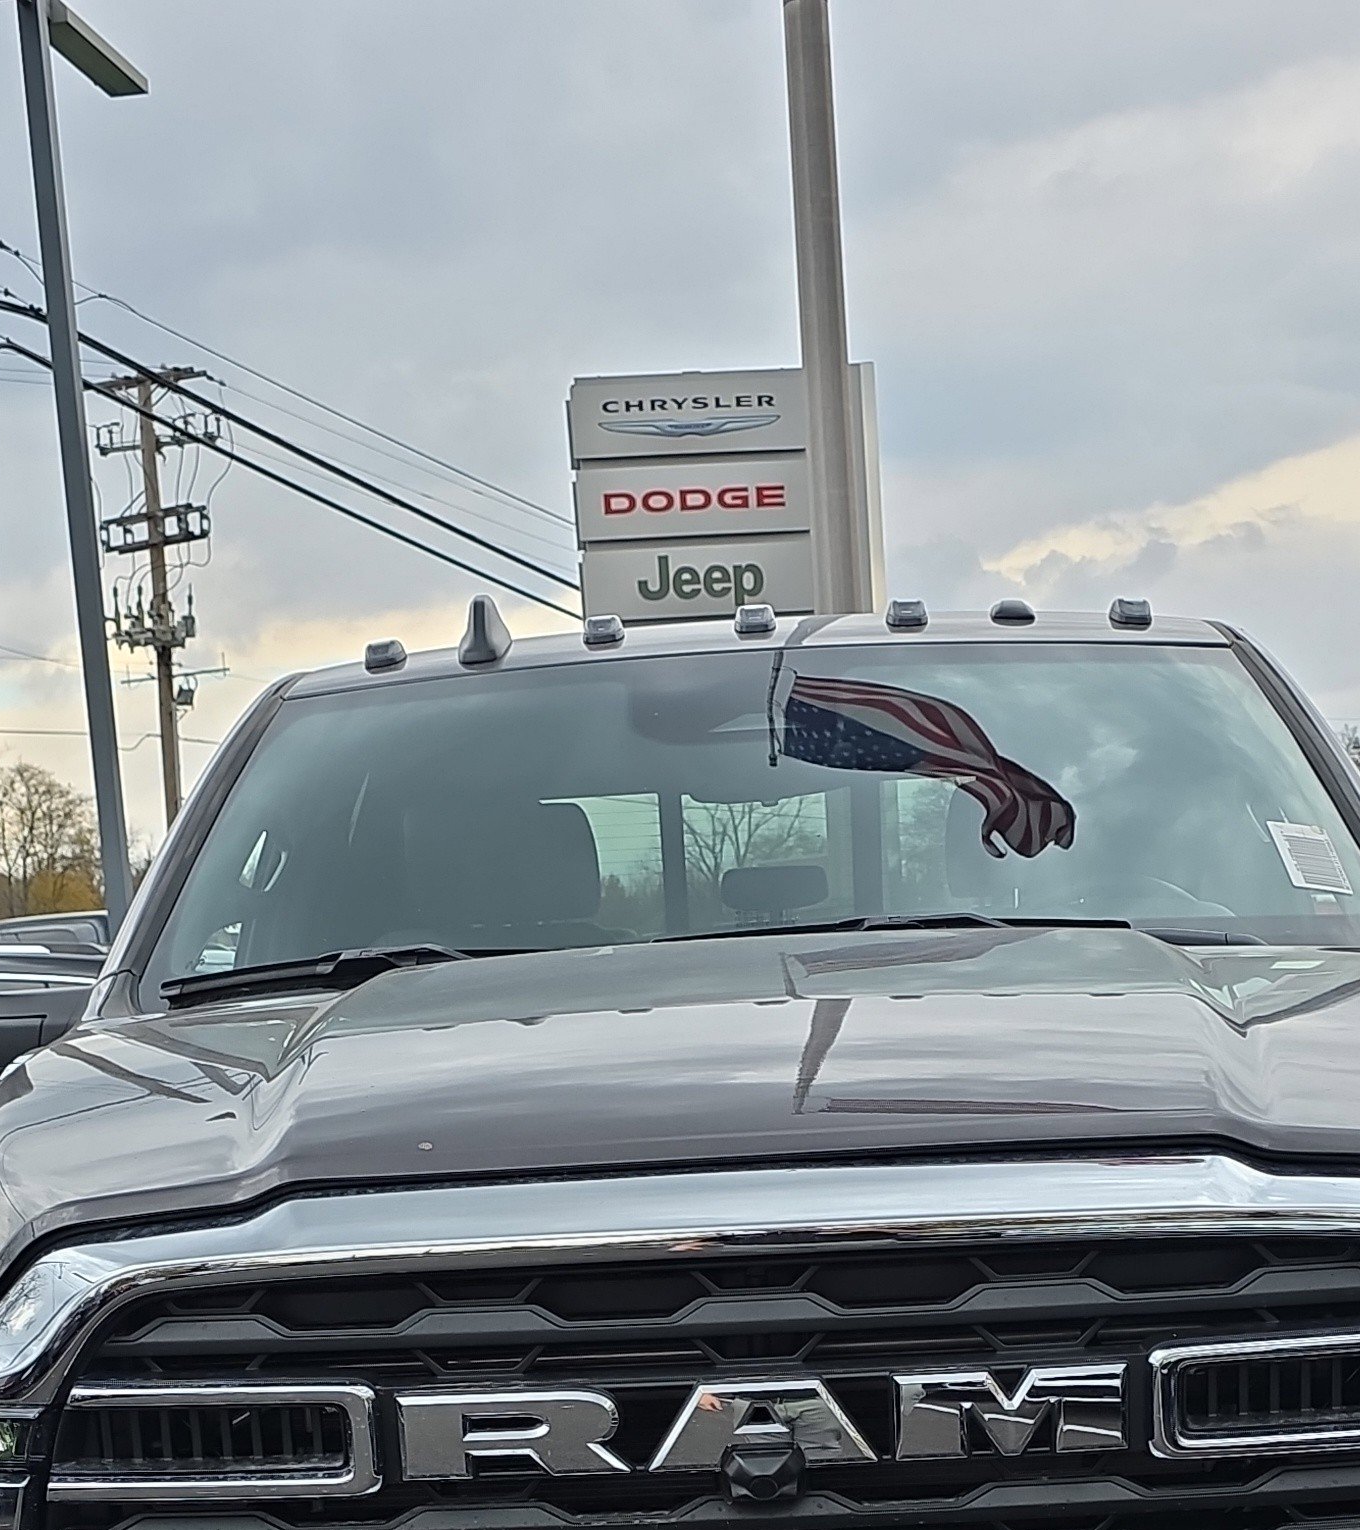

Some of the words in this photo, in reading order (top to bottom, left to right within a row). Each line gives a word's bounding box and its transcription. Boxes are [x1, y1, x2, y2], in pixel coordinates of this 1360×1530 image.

[602, 394, 776, 413] CHRYSLER
[603, 485, 786, 515] DODGE
[637, 555, 764, 606] Jeep
[395, 1362, 1128, 1481] RAM
